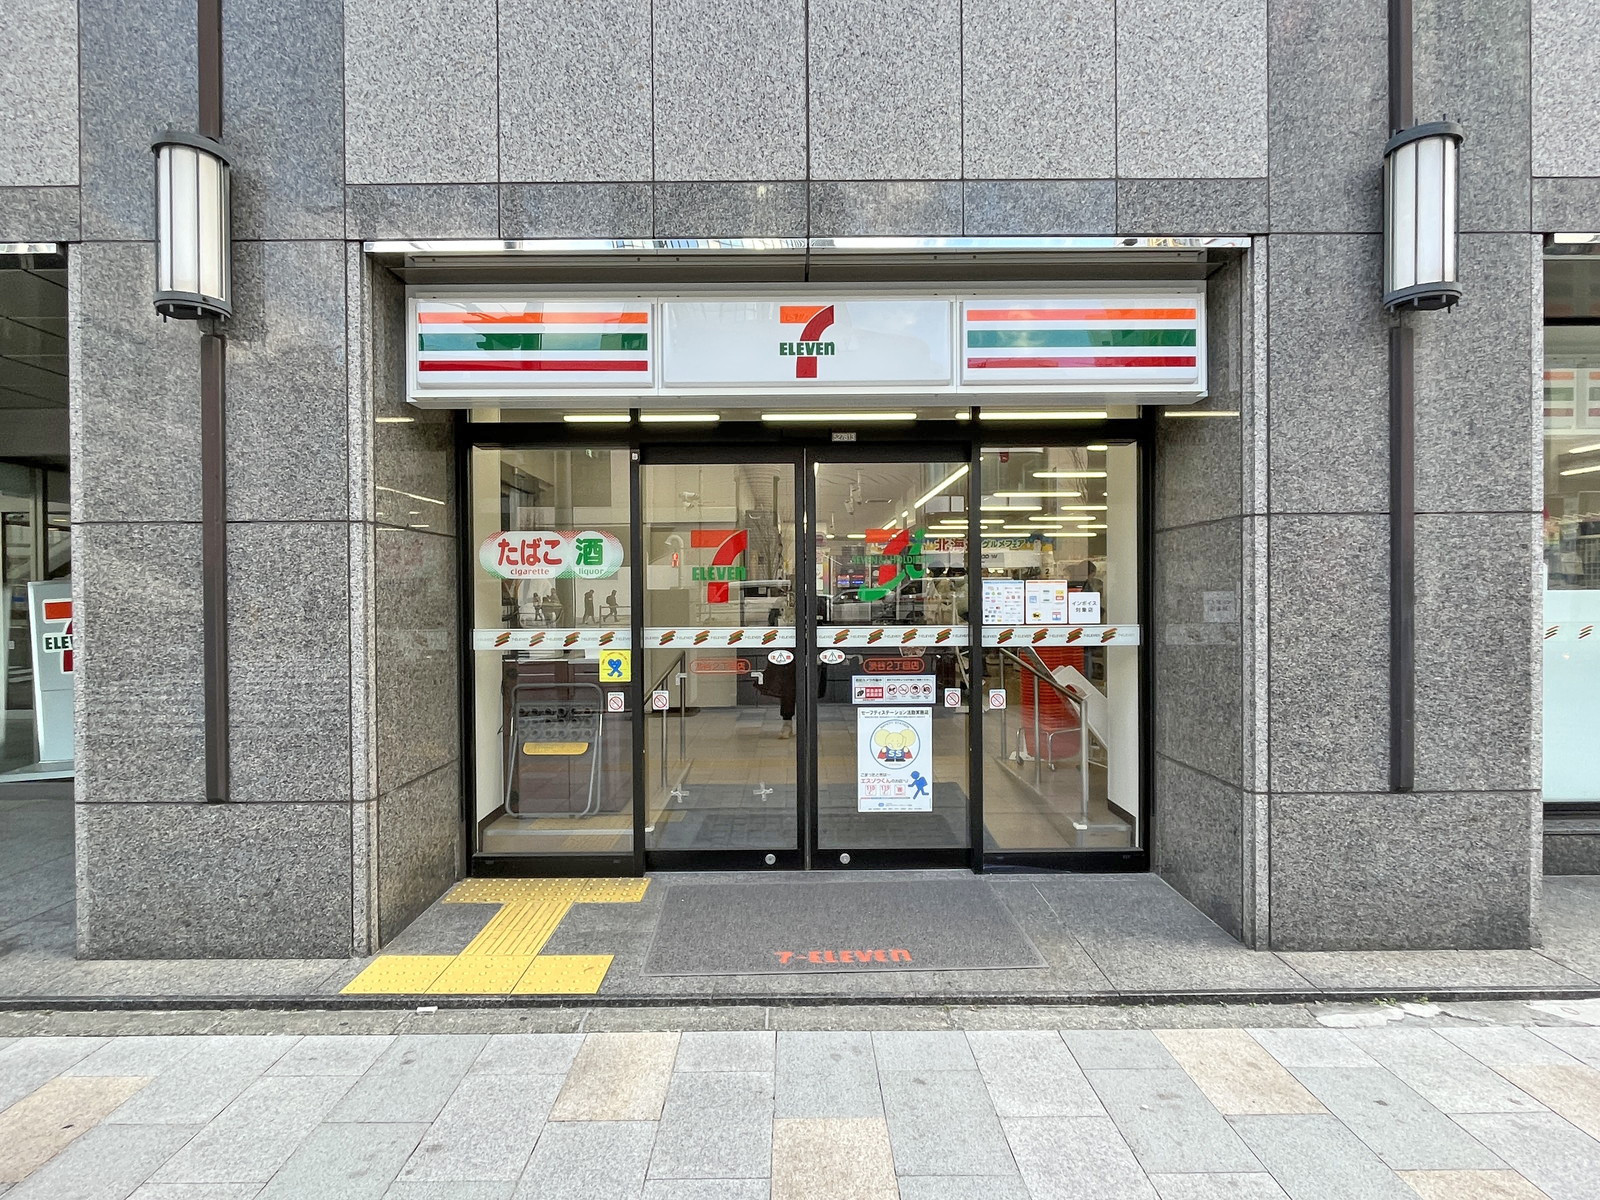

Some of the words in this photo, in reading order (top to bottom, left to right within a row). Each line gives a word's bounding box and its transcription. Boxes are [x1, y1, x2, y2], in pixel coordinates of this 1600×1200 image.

[780, 305, 834, 378] 7
[498, 538, 562, 566] たばこ
[576, 538, 603, 566] 酒
[510, 568, 549, 576] cigarette
[578, 567, 604, 576] liquor
[691, 529, 748, 603] 7
